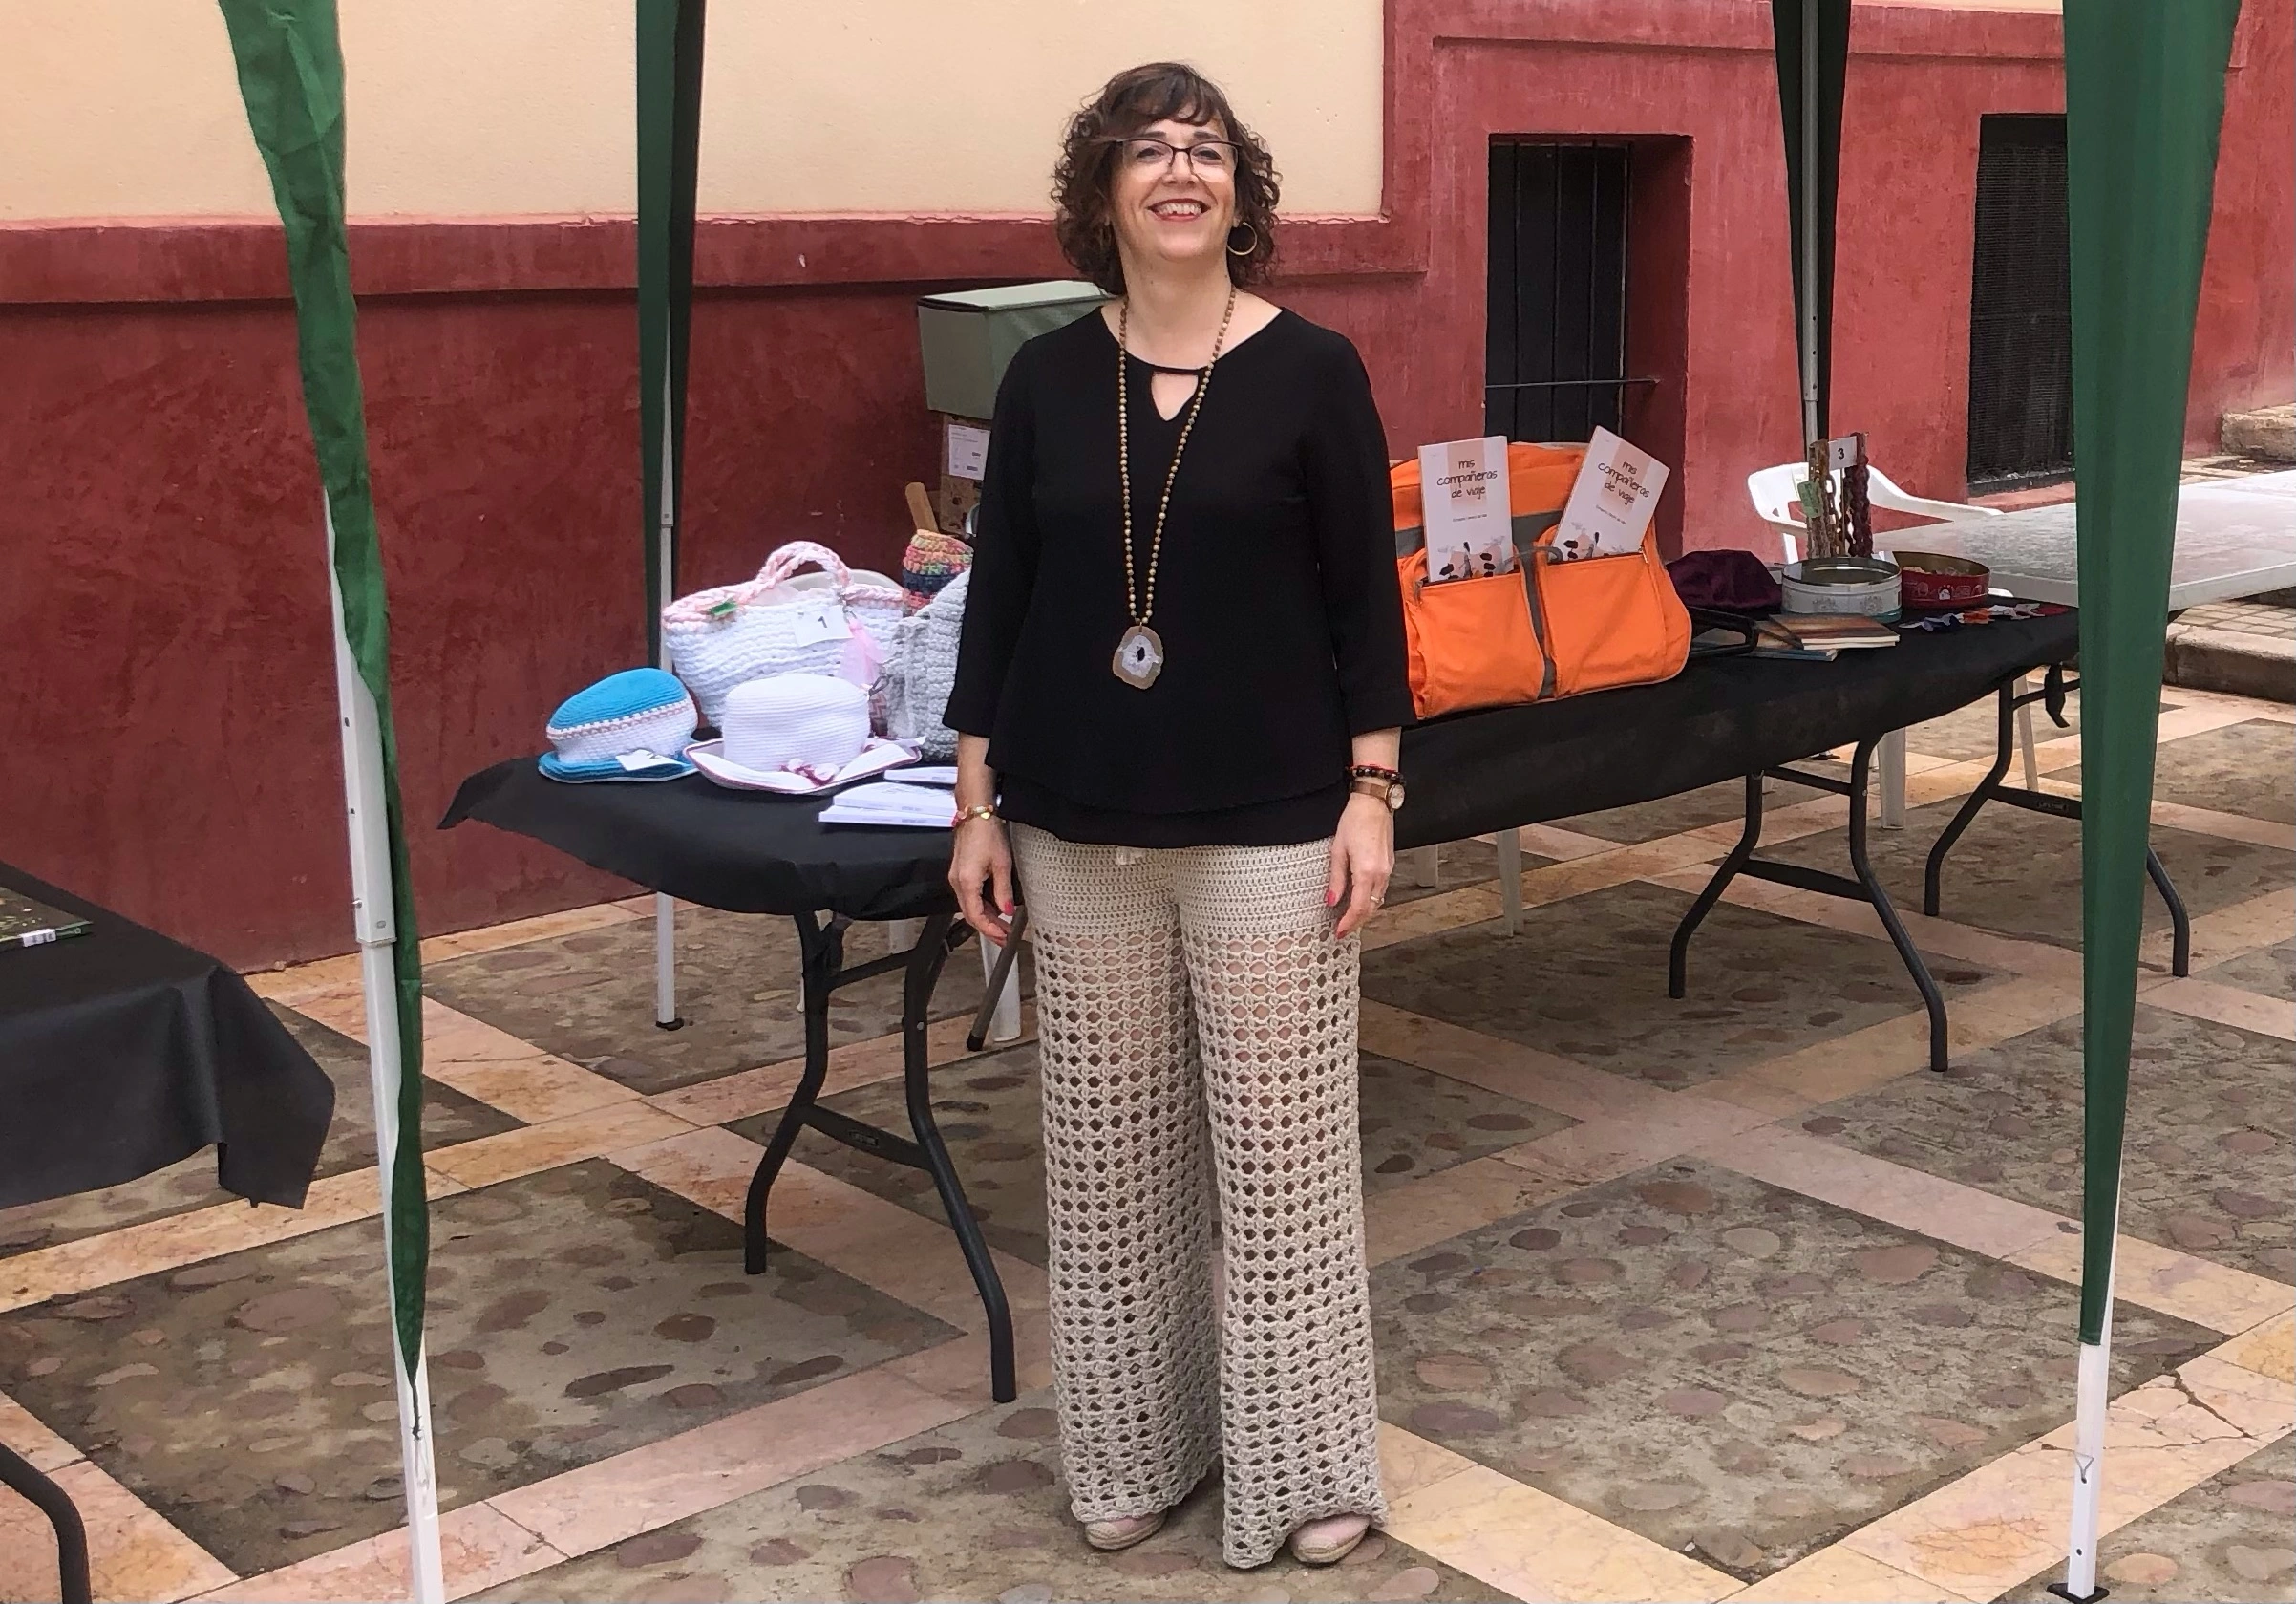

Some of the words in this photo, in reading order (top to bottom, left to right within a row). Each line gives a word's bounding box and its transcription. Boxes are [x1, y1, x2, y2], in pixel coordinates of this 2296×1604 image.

[1838, 447, 1845, 460] 3
[1458, 460, 1476, 469] mis
[1622, 461, 1638, 474] mis
[1436, 470, 1498, 488] compañeras
[1598, 463, 1650, 498] compañeras
[1451, 488, 1463, 498] de
[1466, 485, 1486, 500] viaje
[1604, 481, 1616, 492] de
[1618, 489, 1635, 506] viaje
[818, 616, 827, 628] 1
